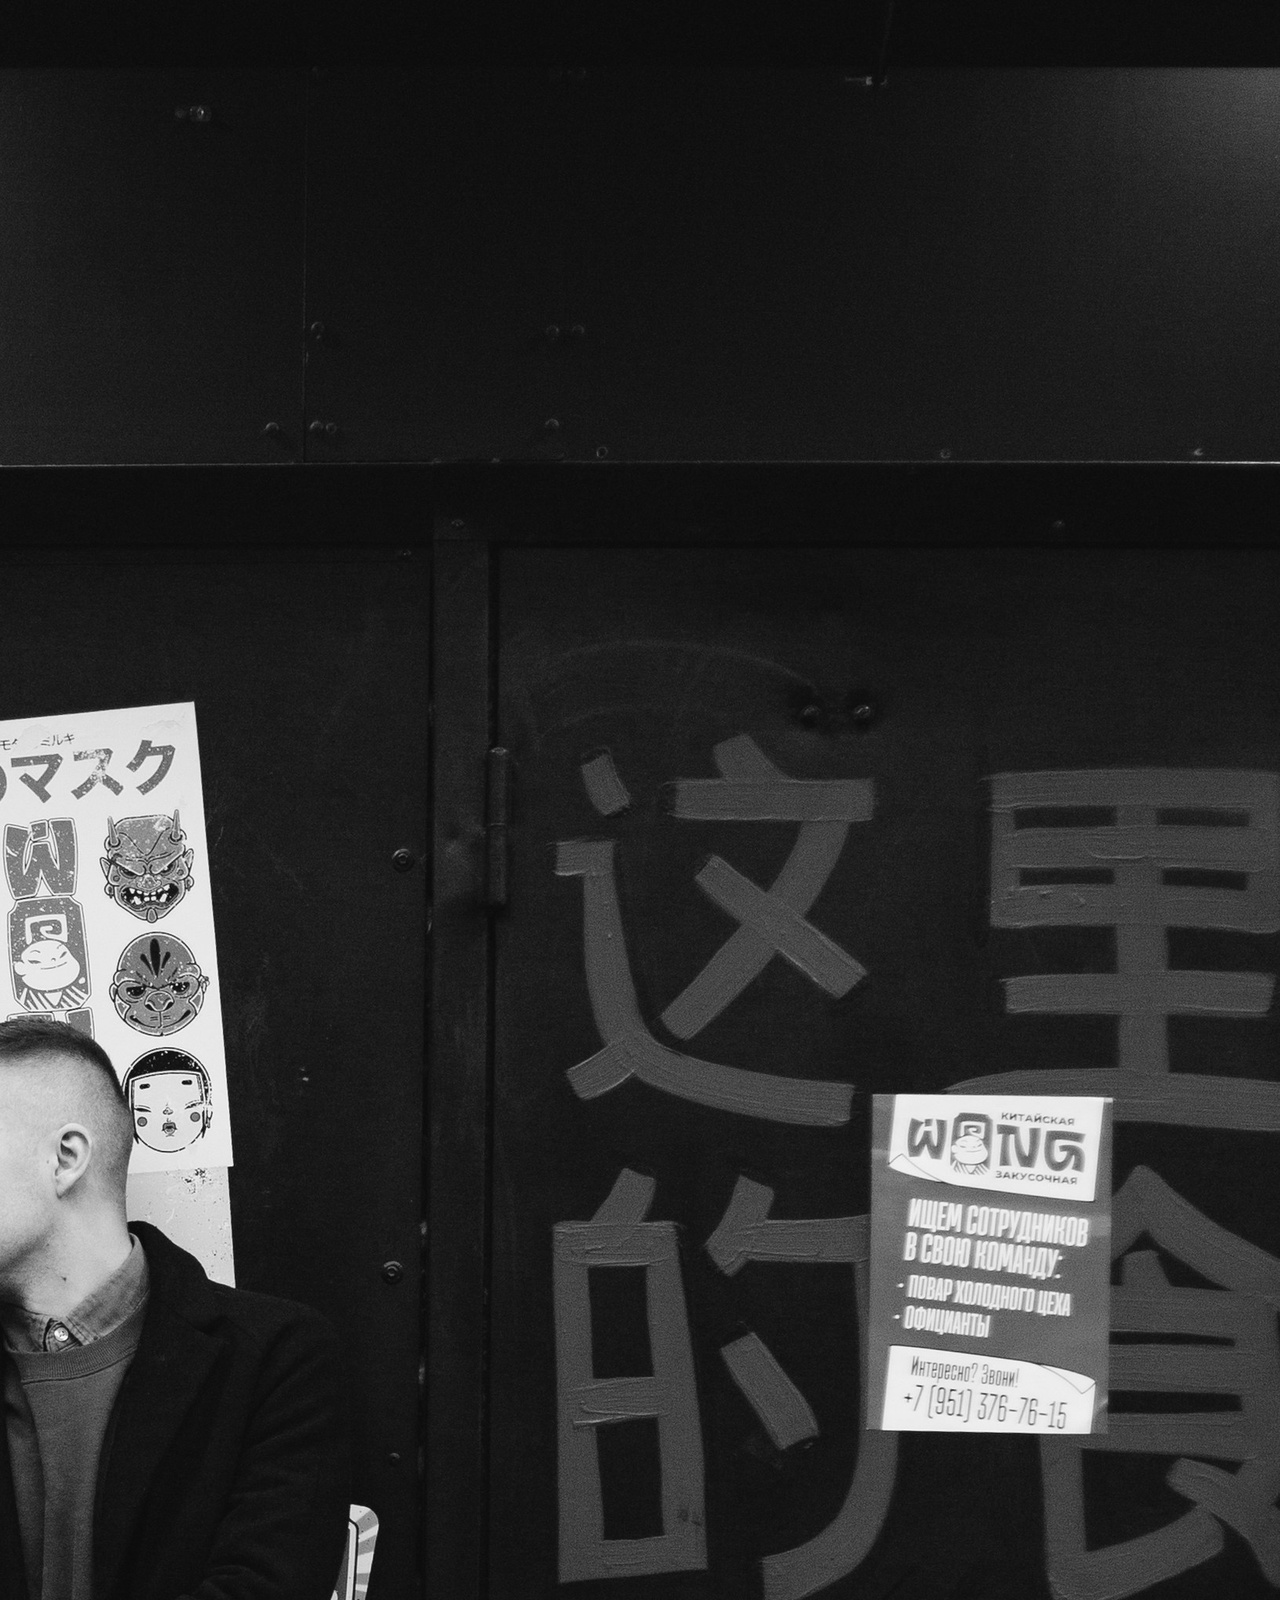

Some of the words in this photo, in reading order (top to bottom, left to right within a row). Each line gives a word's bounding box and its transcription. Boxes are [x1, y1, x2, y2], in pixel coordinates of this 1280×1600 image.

[1001, 1112, 1075, 1126] КИТАЙСКАЯ
[995, 1170, 1078, 1185] ЗАКУСОЧНАЯ
[908, 1198, 963, 1233] ИЩЕМ
[966, 1205, 1089, 1247] СОТРУДНИКОВ
[904, 1232, 918, 1261] В
[920, 1233, 971, 1268] СВОЮ
[973, 1240, 1063, 1280] КОМАНДУ:
[908, 1274, 954, 1302] ПОВАР
[954, 1280, 1035, 1312] ХОЛОДНОГО
[1037, 1290, 1071, 1317] ЦЕХА
[904, 1305, 992, 1338] ОФИЦИАНТЫ
[910, 1355, 979, 1384] Интересно?
[981, 1363, 1020, 1388] Звони!
[904, 1385, 924, 1412] +7
[977, 1392, 1068, 1430] 376-76-15
